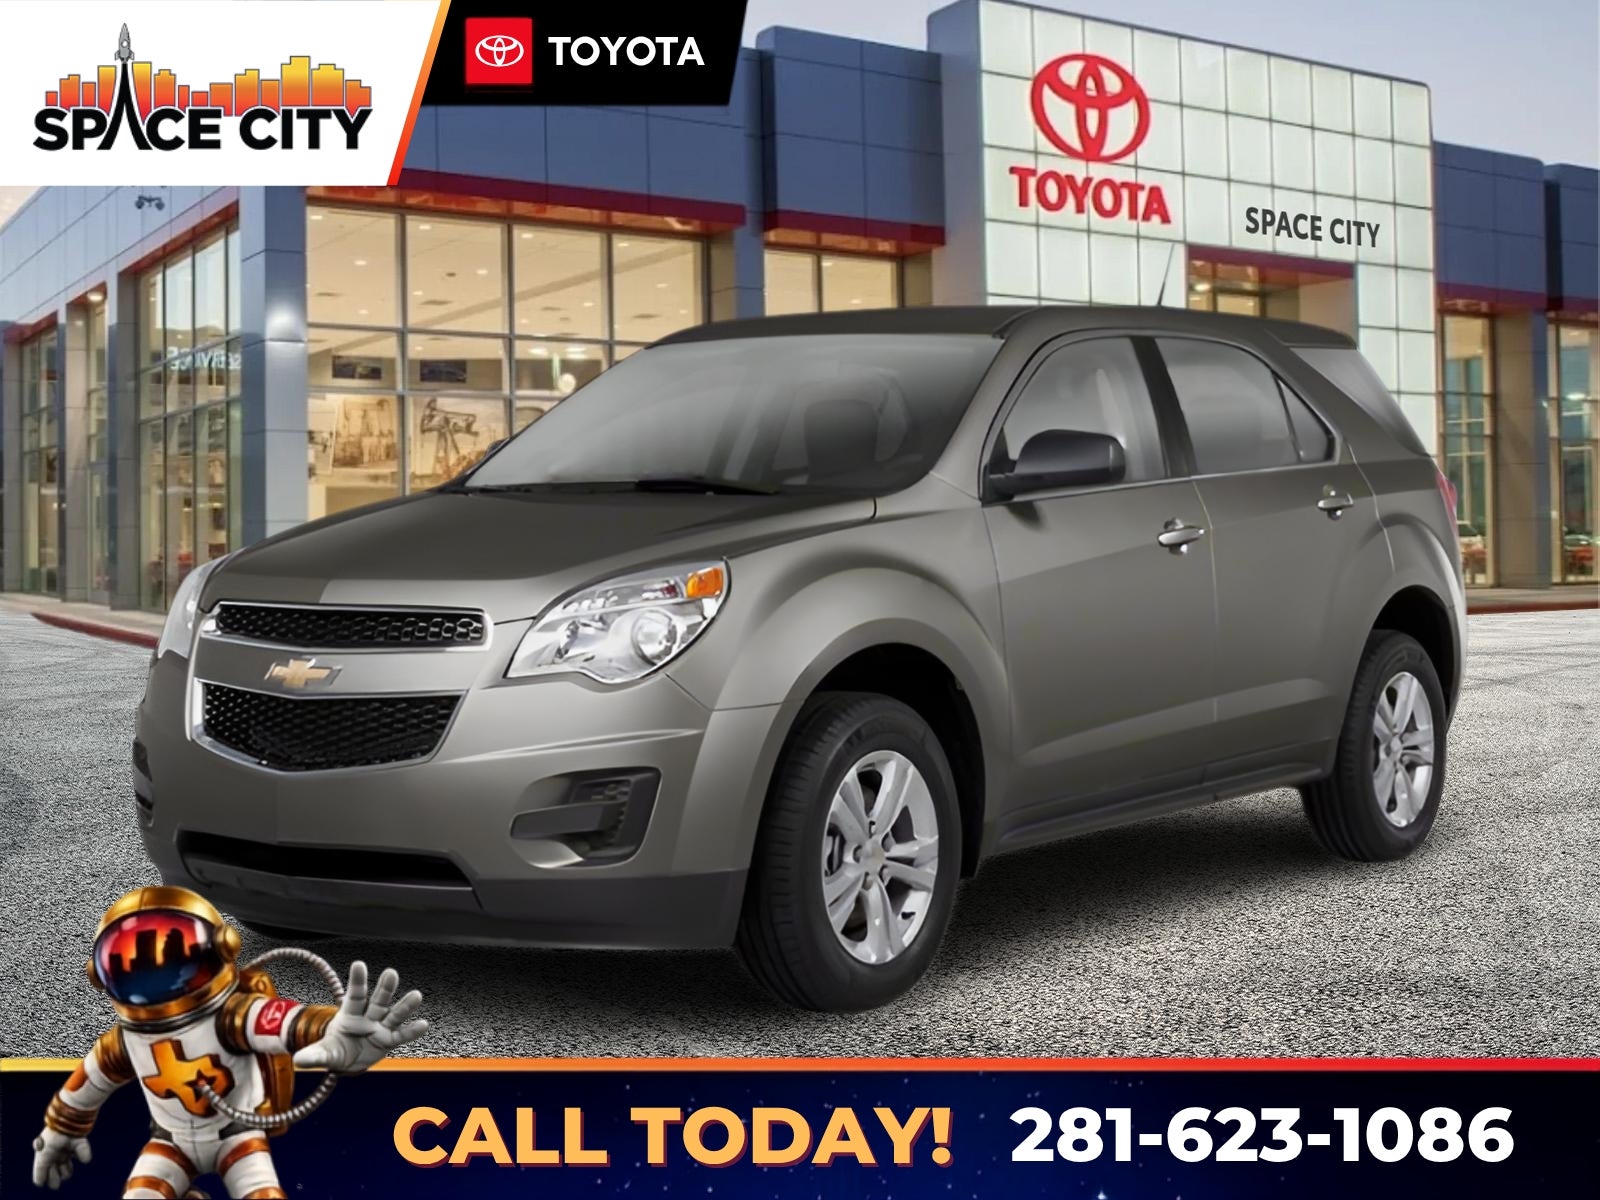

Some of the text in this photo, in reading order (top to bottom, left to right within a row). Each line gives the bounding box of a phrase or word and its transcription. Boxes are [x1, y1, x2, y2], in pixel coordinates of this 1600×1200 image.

[1009, 166, 1171, 225] TOYOTA
[1245, 207, 1381, 248] SPACE CITY
